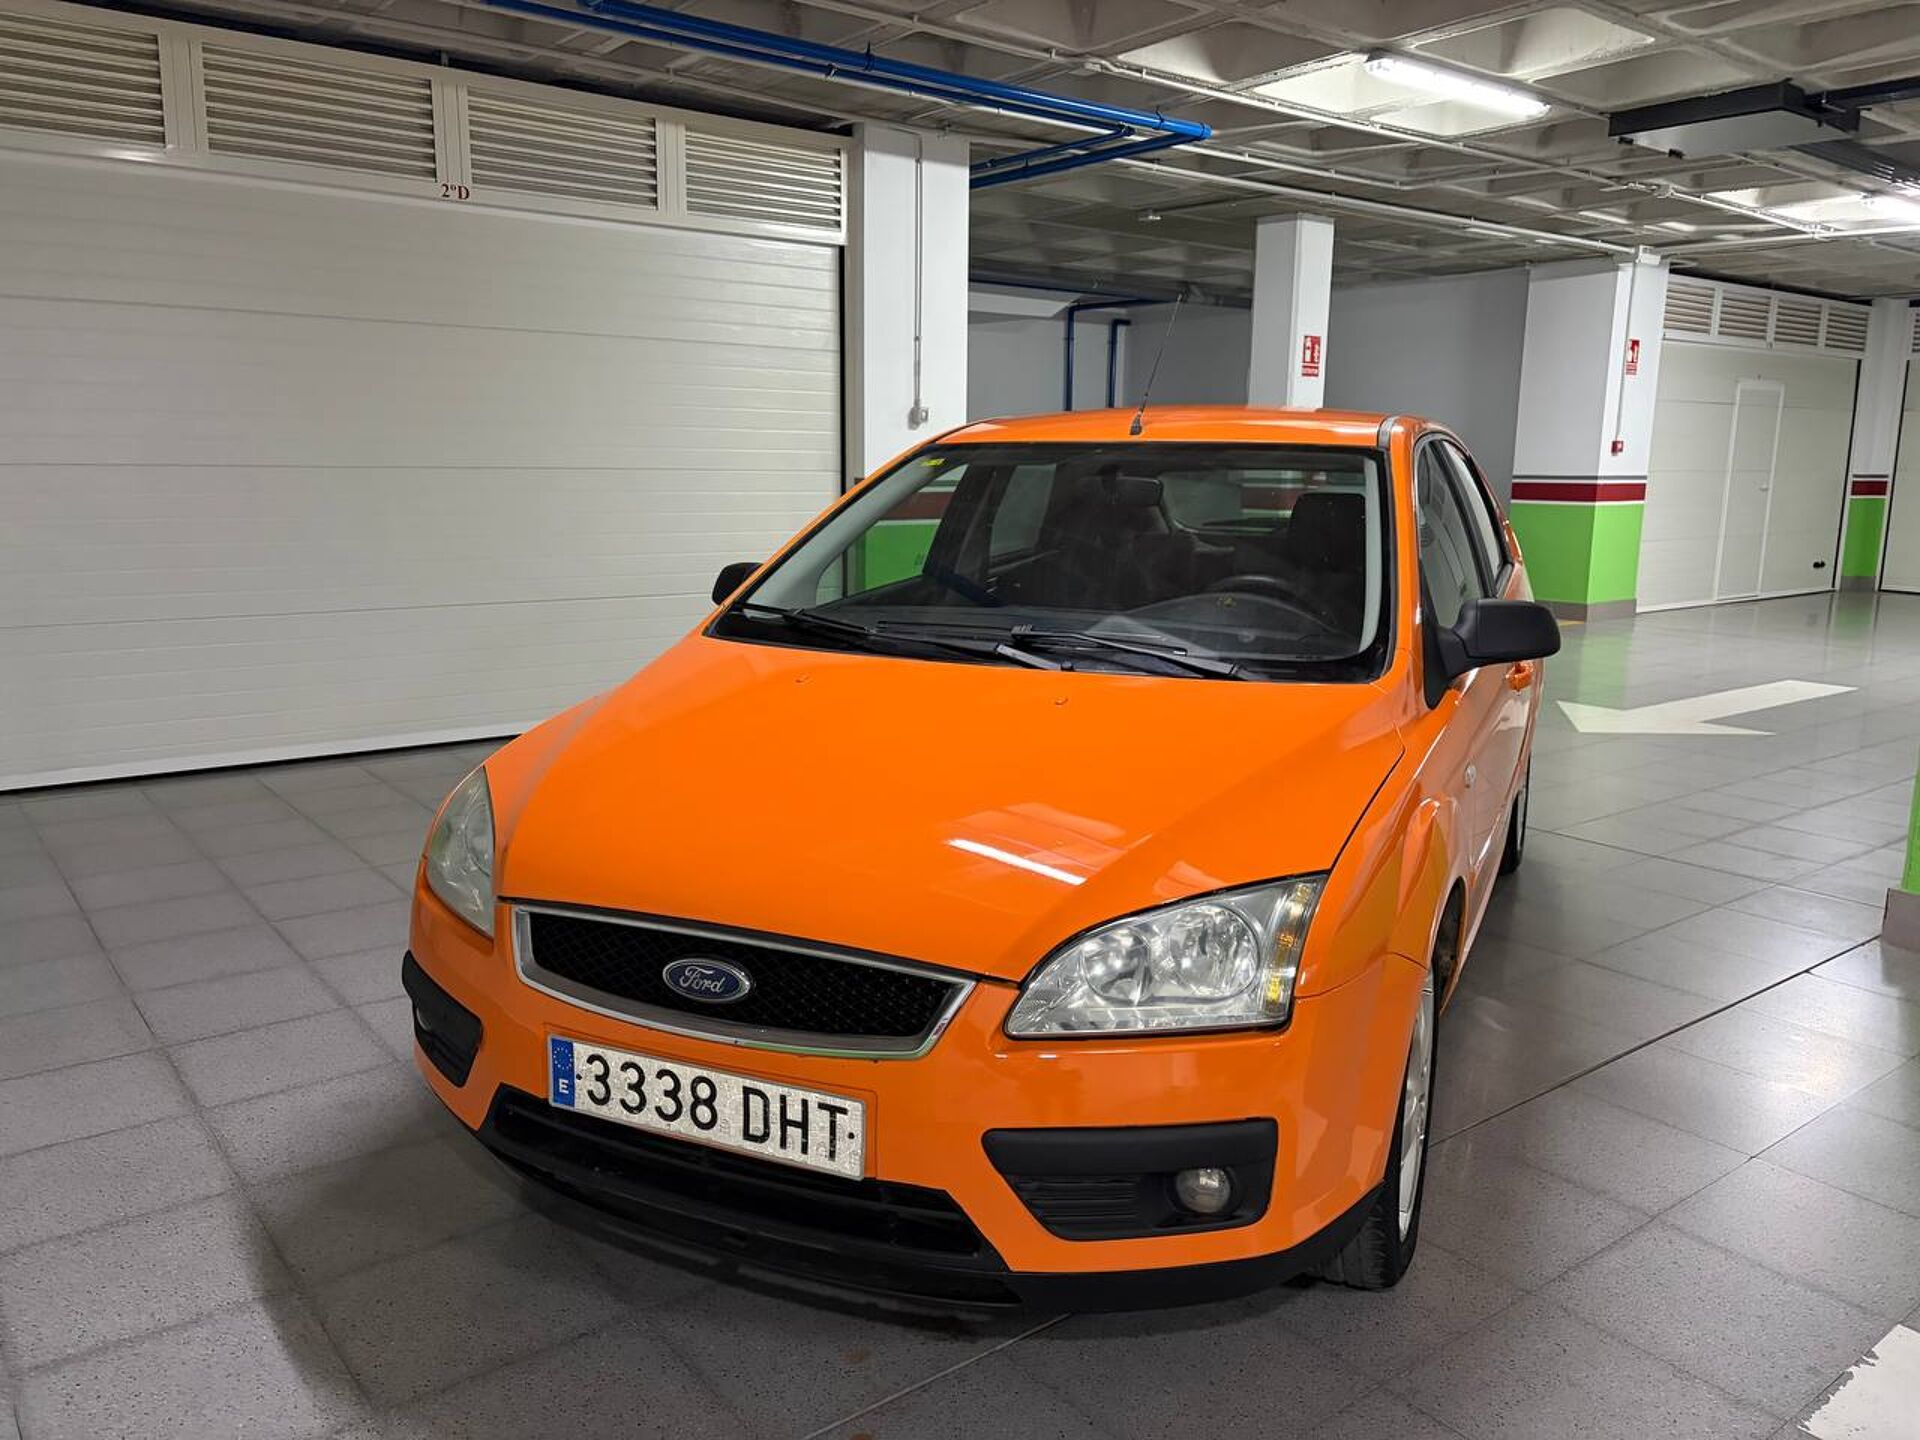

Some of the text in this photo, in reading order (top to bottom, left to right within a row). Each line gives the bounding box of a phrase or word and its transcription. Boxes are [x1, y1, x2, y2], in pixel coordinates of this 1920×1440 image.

[680, 966, 725, 993] Ford
[559, 1078, 569, 1095] E
[586, 1053, 849, 1161] 3338 DHT
